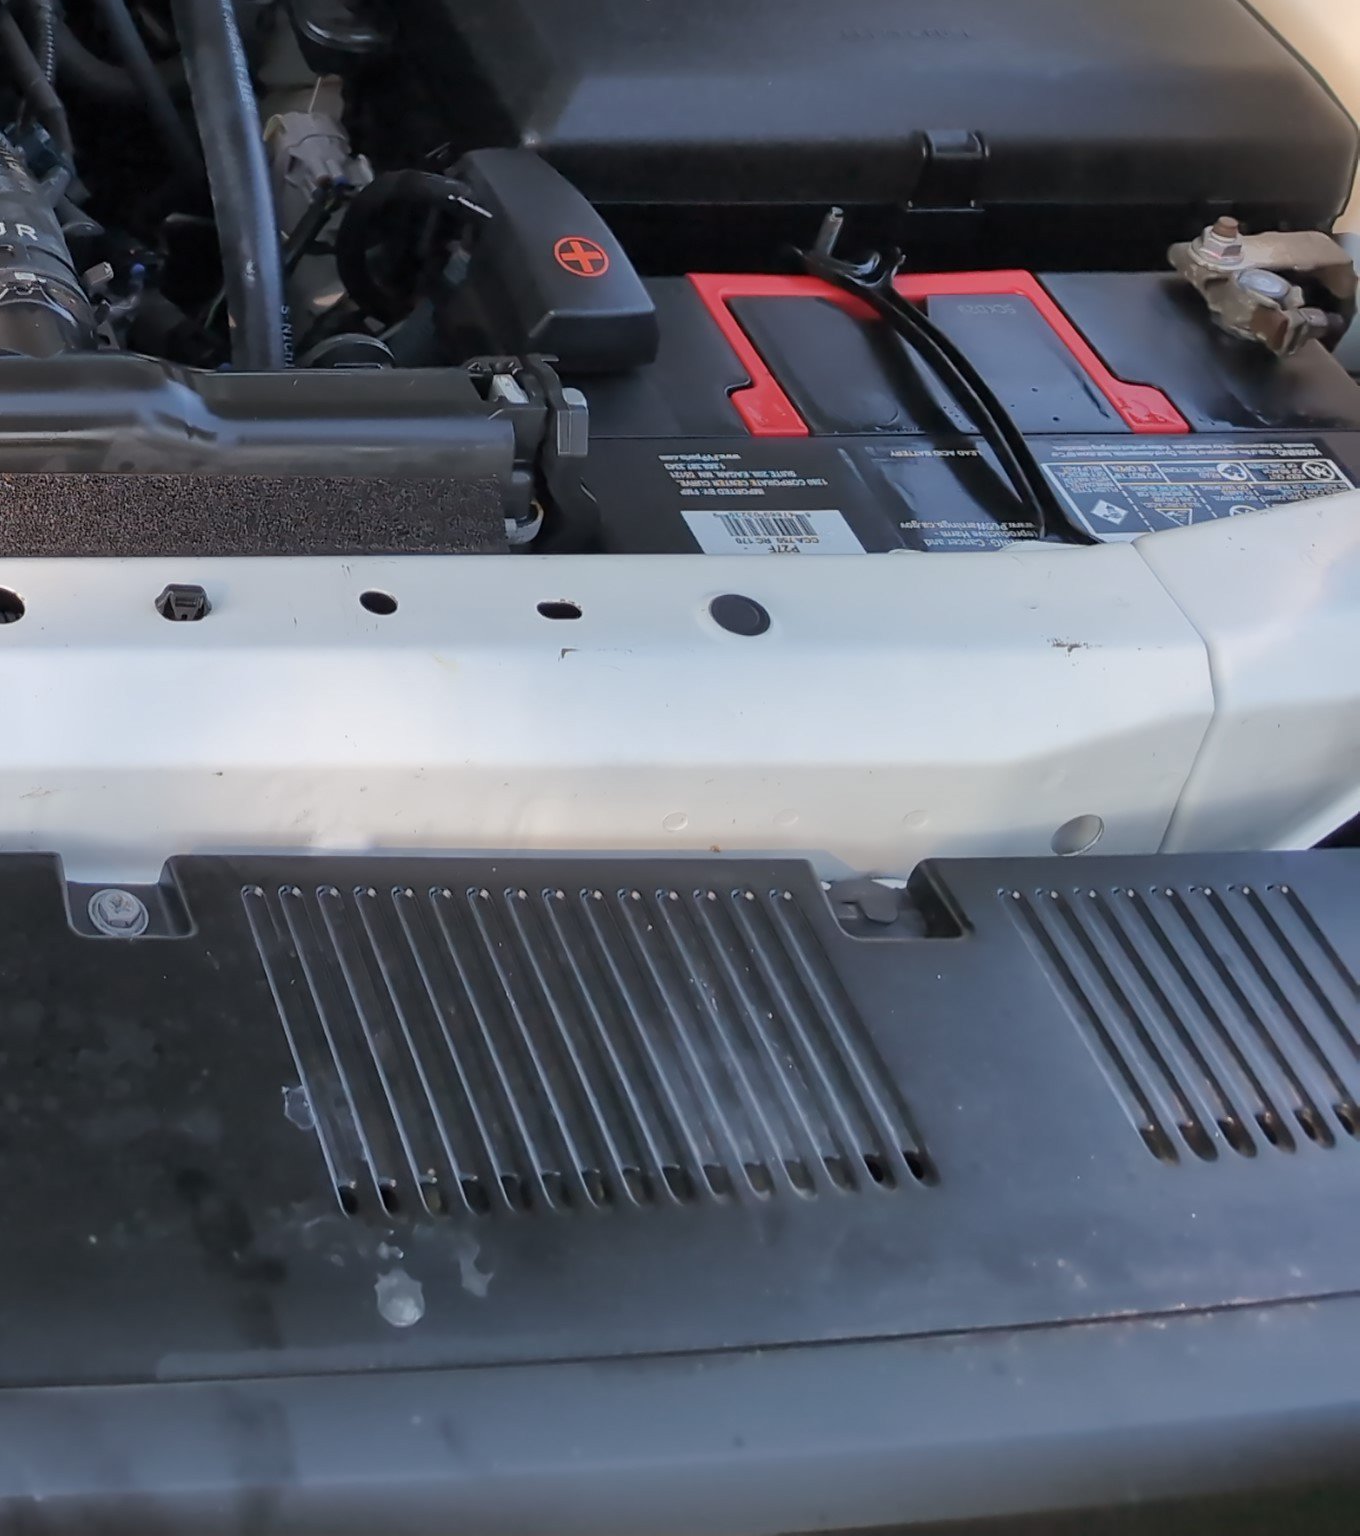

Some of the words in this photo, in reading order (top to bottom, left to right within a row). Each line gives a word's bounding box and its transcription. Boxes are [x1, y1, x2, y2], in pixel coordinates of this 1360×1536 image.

[717, 488, 765, 496] IMPORTED
[923, 538, 945, 547] and
[946, 538, 985, 547] Cancer
